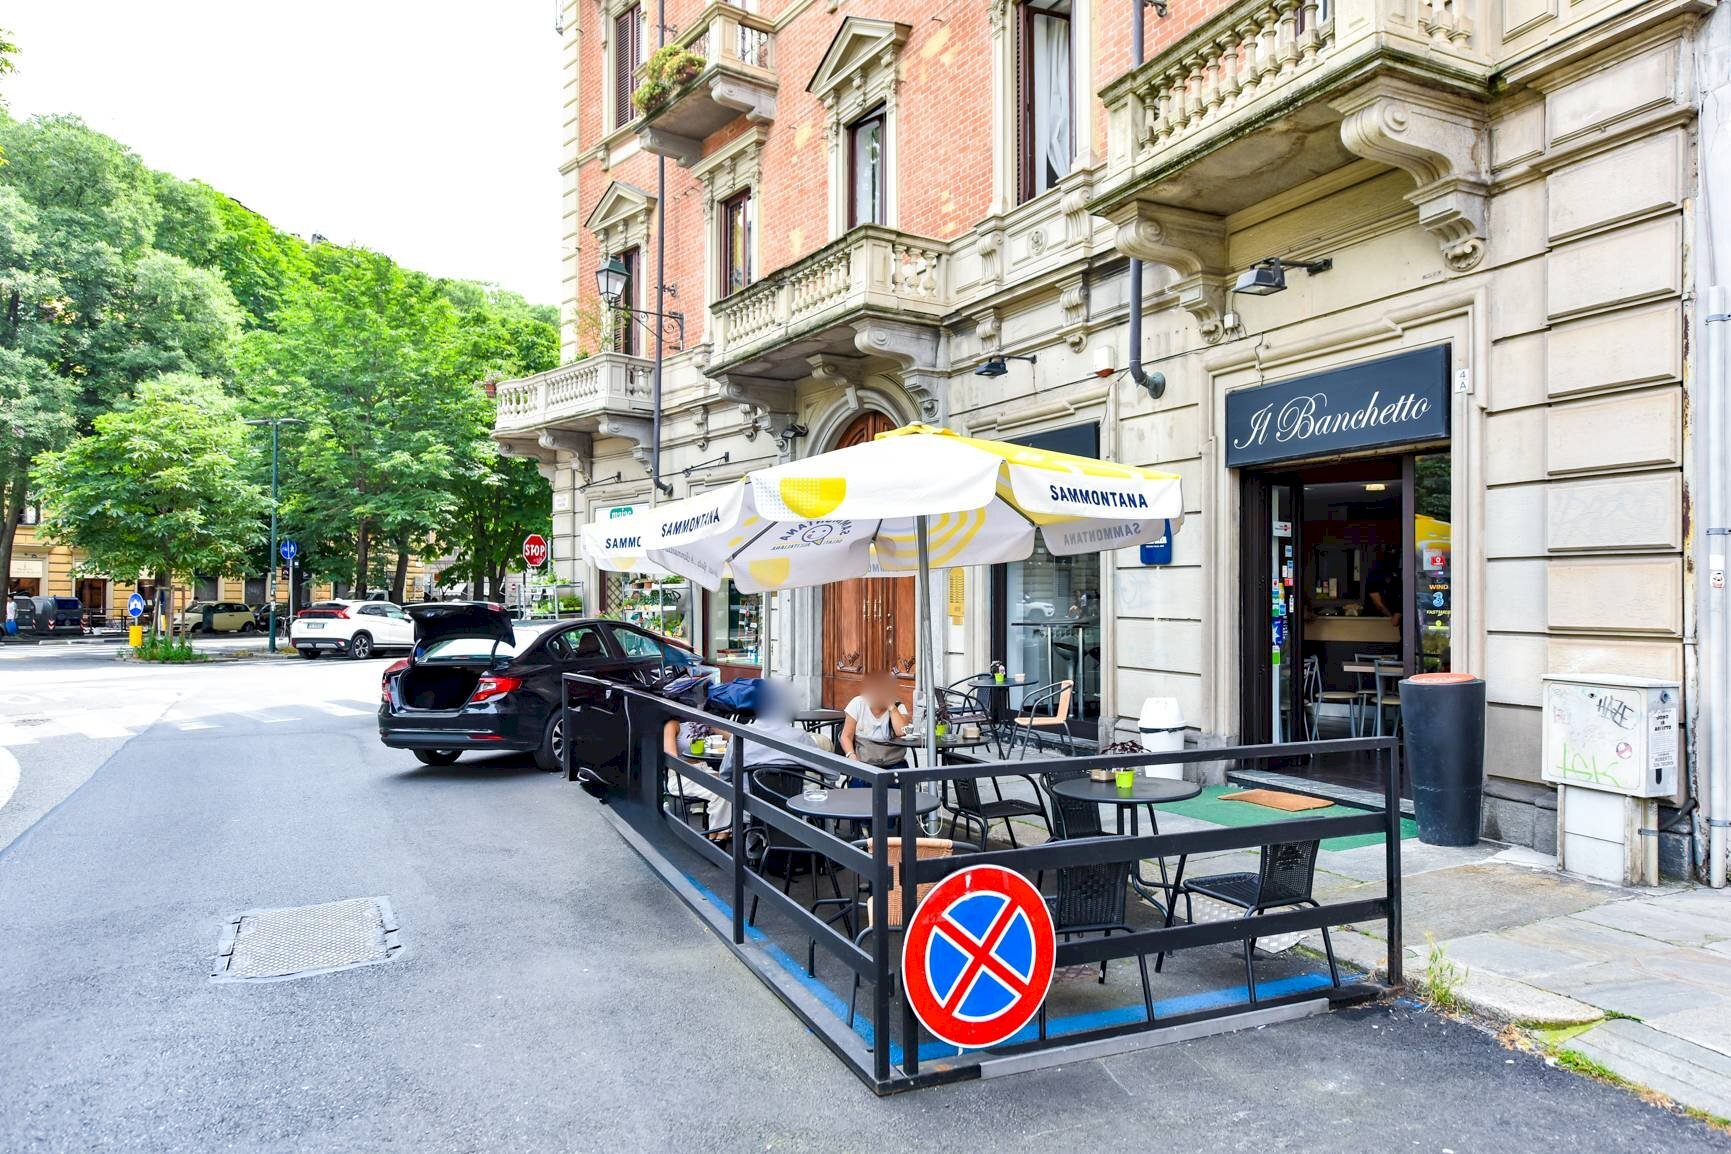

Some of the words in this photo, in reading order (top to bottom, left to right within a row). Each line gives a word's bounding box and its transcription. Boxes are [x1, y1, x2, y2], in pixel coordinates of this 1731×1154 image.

[1234, 403, 1274, 449] Il
[1276, 391, 1432, 442] Banchetto
[1049, 484, 1149, 508] SAMMONTANA
[661, 507, 720, 538] SAMMONTANA
[525, 544, 545, 556] STOP
